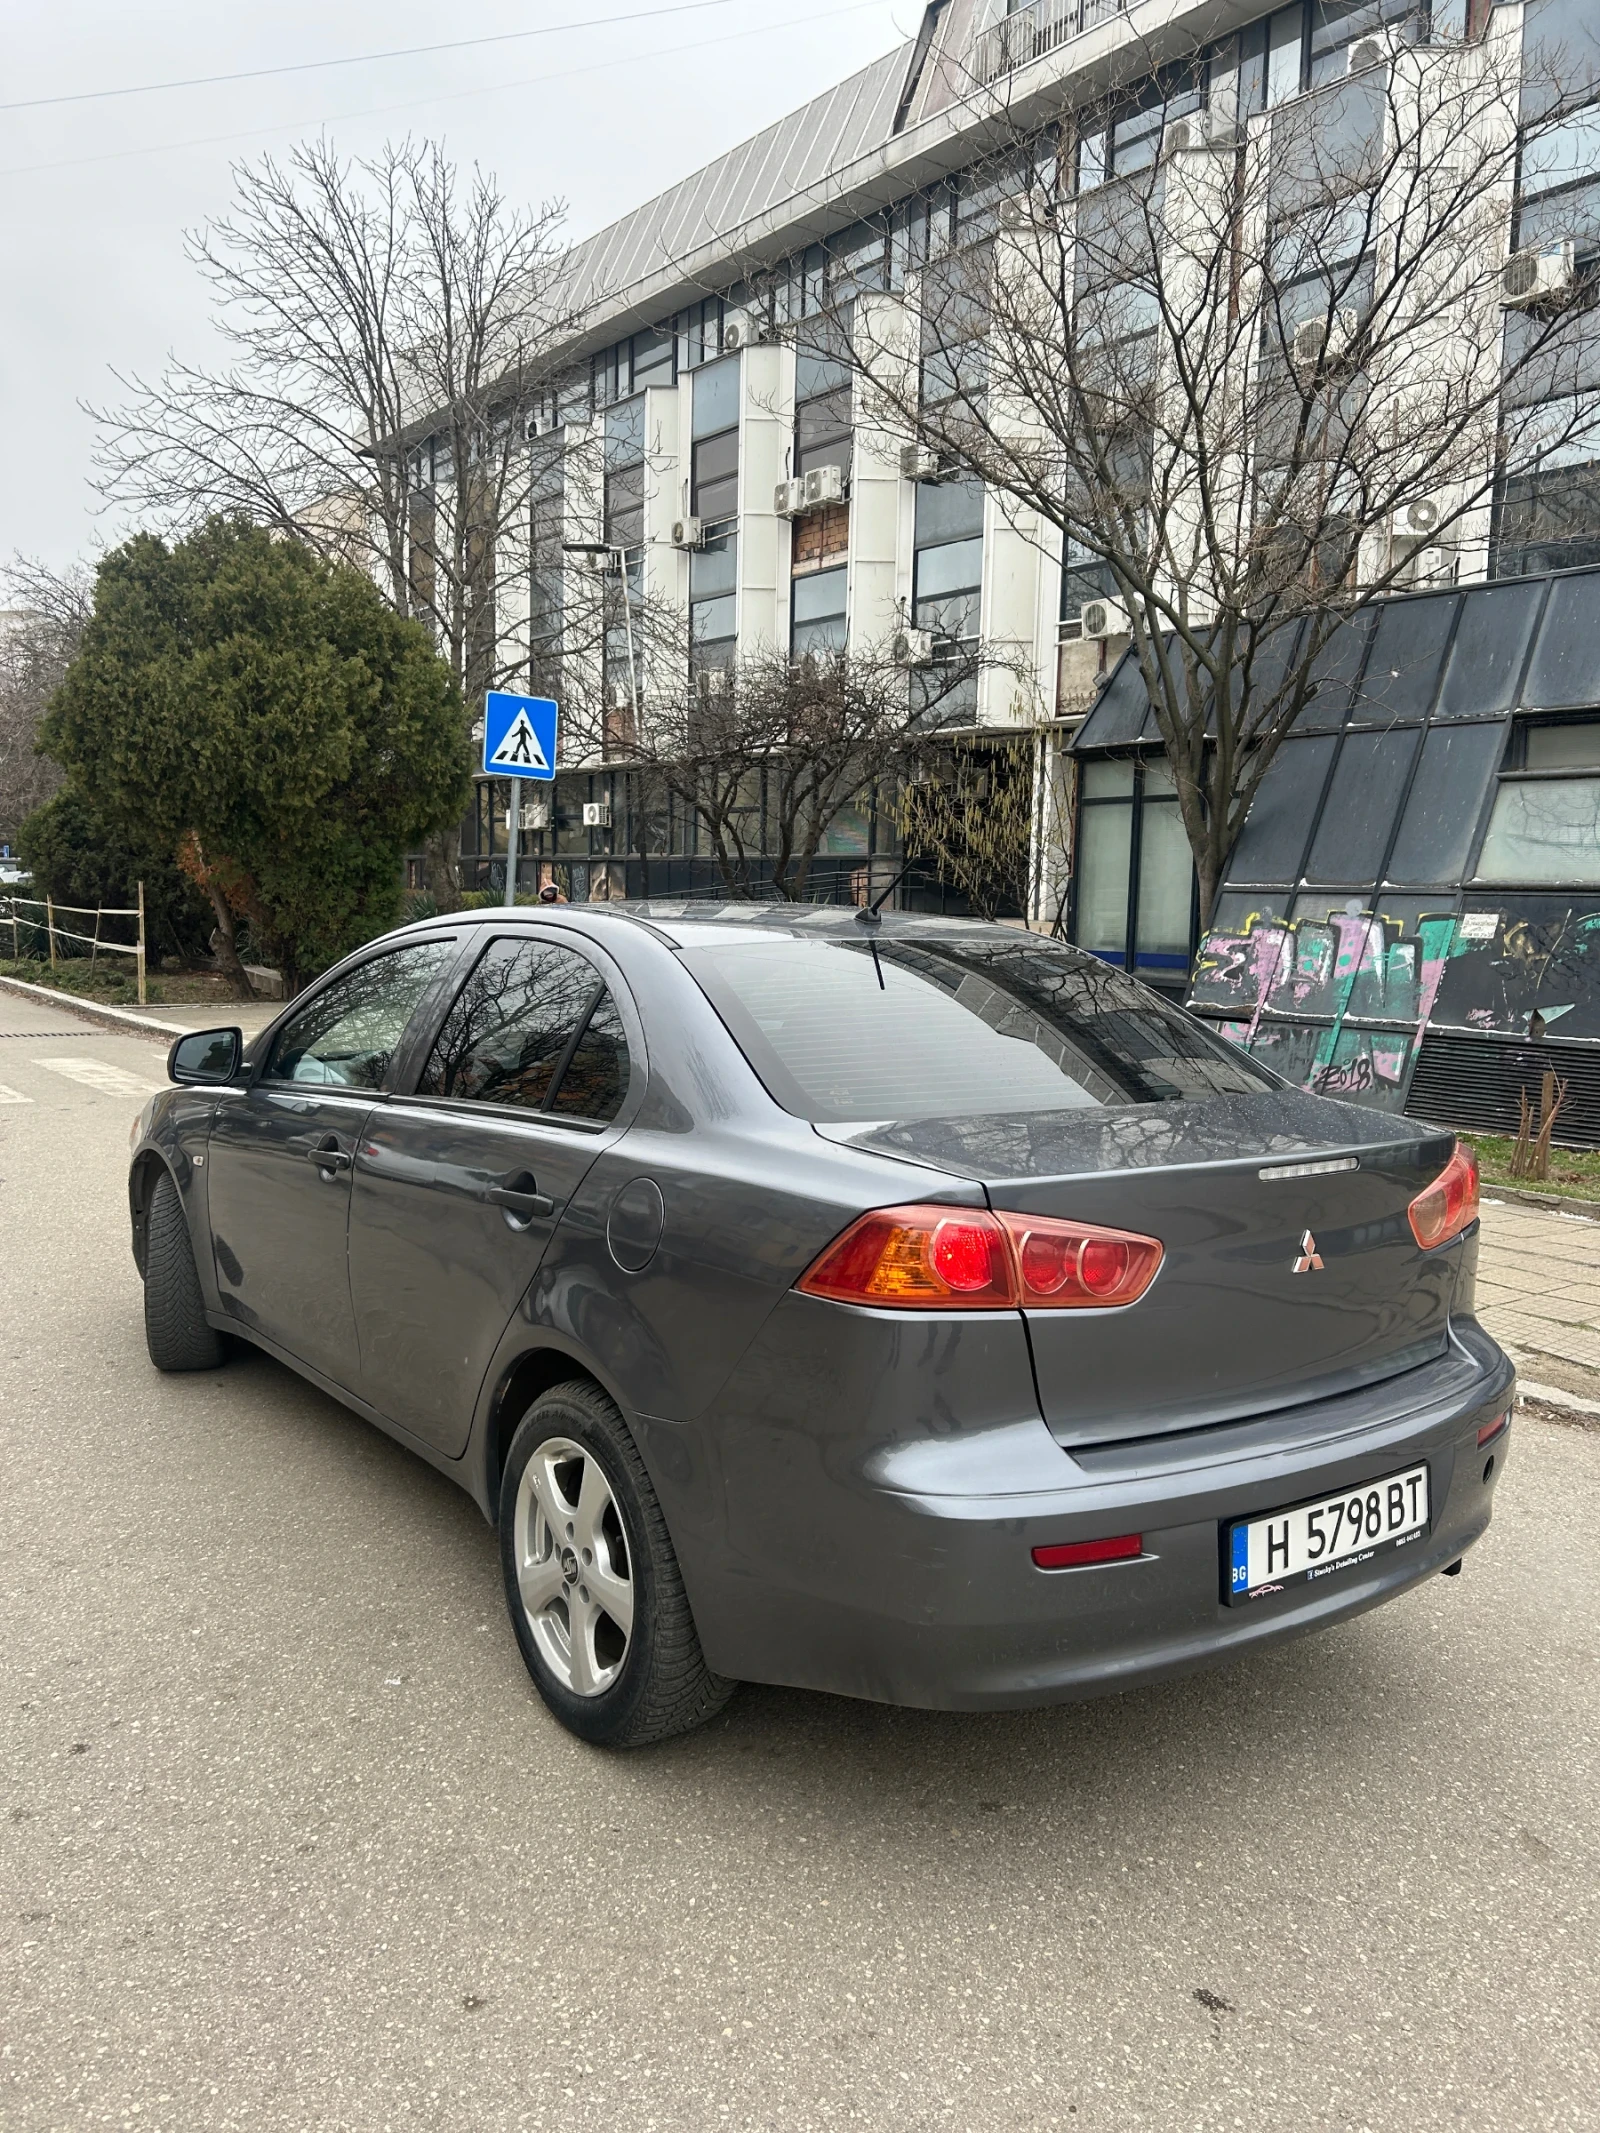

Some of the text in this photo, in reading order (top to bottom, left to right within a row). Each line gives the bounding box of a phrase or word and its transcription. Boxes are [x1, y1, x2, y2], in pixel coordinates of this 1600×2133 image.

[1267, 1474, 1423, 1575] H 5798 BT
[1335, 1556, 1358, 1570] Detailing
[1233, 1565, 1247, 1584] BG
